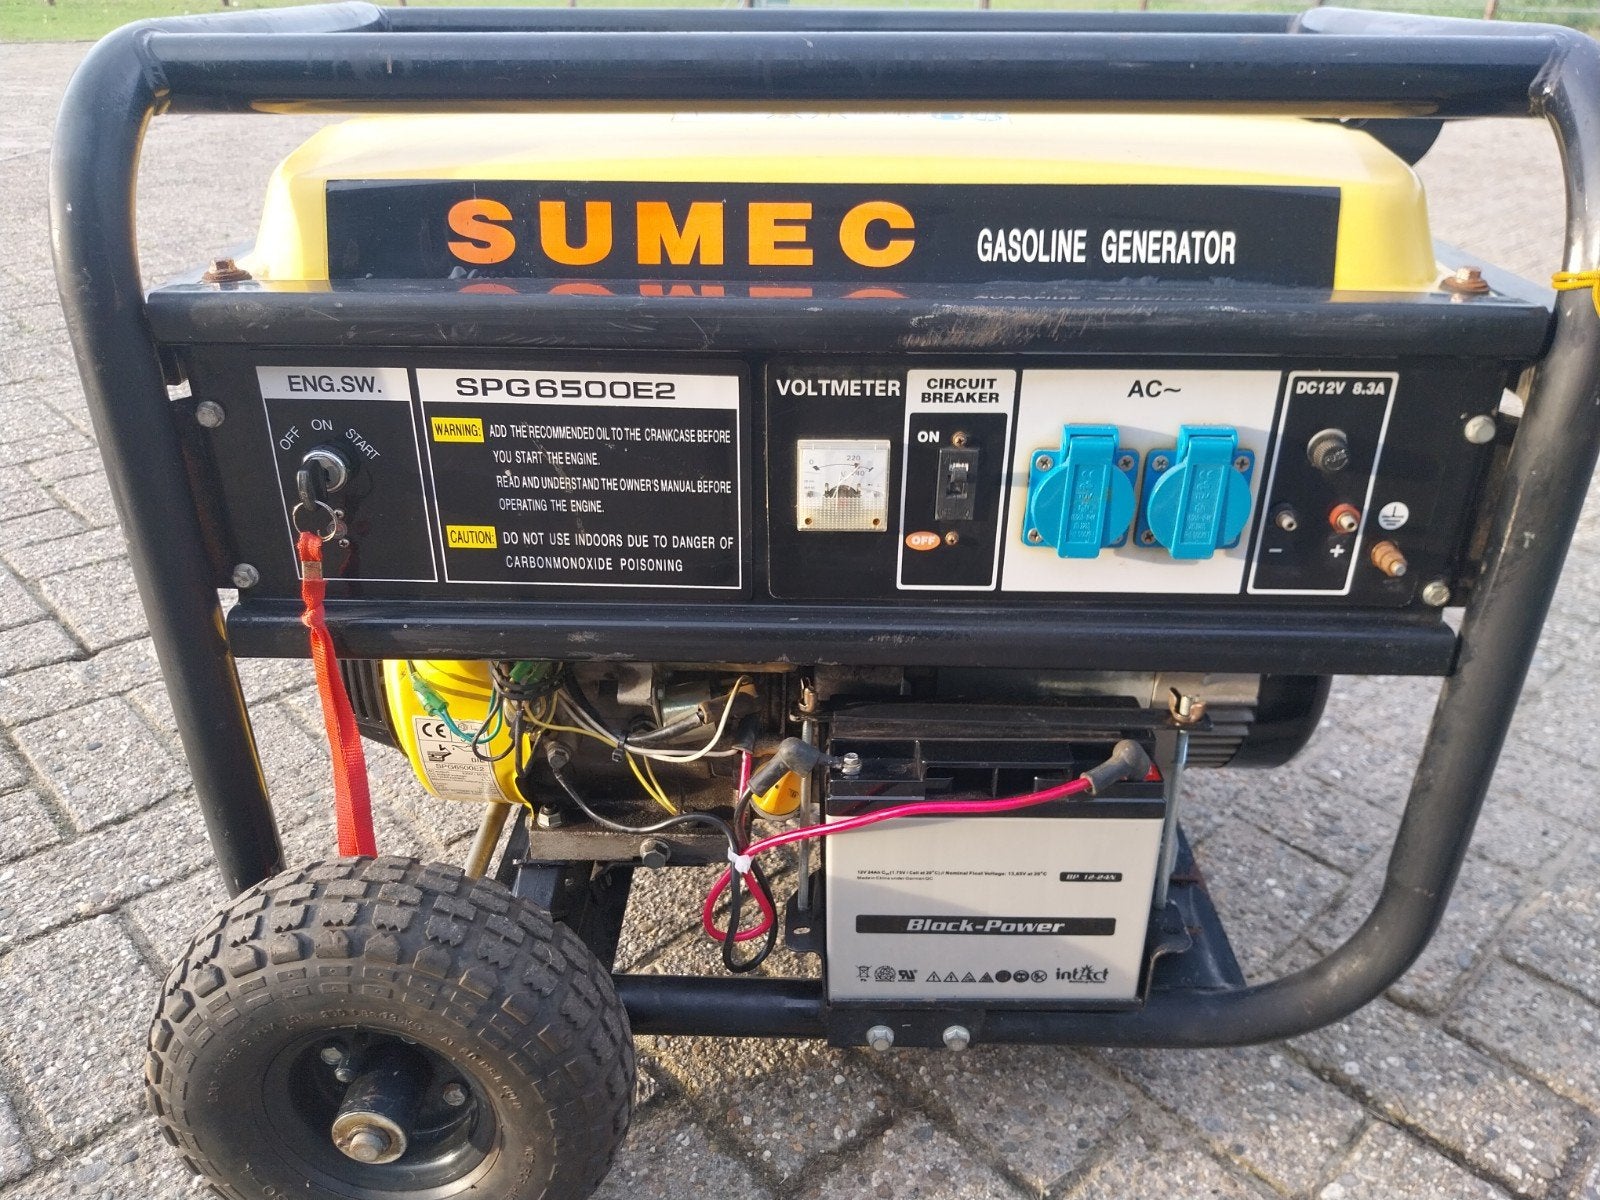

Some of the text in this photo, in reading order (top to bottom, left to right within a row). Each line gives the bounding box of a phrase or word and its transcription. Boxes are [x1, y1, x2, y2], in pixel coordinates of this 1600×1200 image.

[447, 198, 915, 268] SUMEC
[977, 228, 1237, 265] GASOLINE GENERATOR
[287, 375, 382, 394] ENG.SW.
[455, 377, 676, 400] SPG6500E2
[776, 379, 900, 397] VOLTMETER
[926, 378, 997, 390] CIRCUIT
[1295, 380, 1385, 396] DC12V 8.3A
[920, 392, 1000, 404] BREAKER
[311, 419, 333, 431] ON
[434, 423, 482, 437] WARNING:
[279, 425, 300, 451] OFF
[489, 424, 730, 444] ADD THE RECOMMENDED OIL TO THE CRANKCASE BEFORE
[917, 431, 940, 443] ON
[345, 428, 381, 460] START
[494, 450, 600, 466] YOU START THE ENGINE.
[496, 476, 732, 494] READ AND UNDERSTAND THE OWNER'S MANUAL BEFORE
[499, 498, 604, 512] OPERATING THE ENGINE.
[450, 530, 495, 544] CAUTION:
[503, 532, 734, 549] DO NOT USE INDOORS DUE TO DANGER OF
[911, 535, 936, 546] OFF
[506, 556, 683, 572] CARBONMONOXIDE POISONING
[906, 918, 1066, 933] Block-Power
